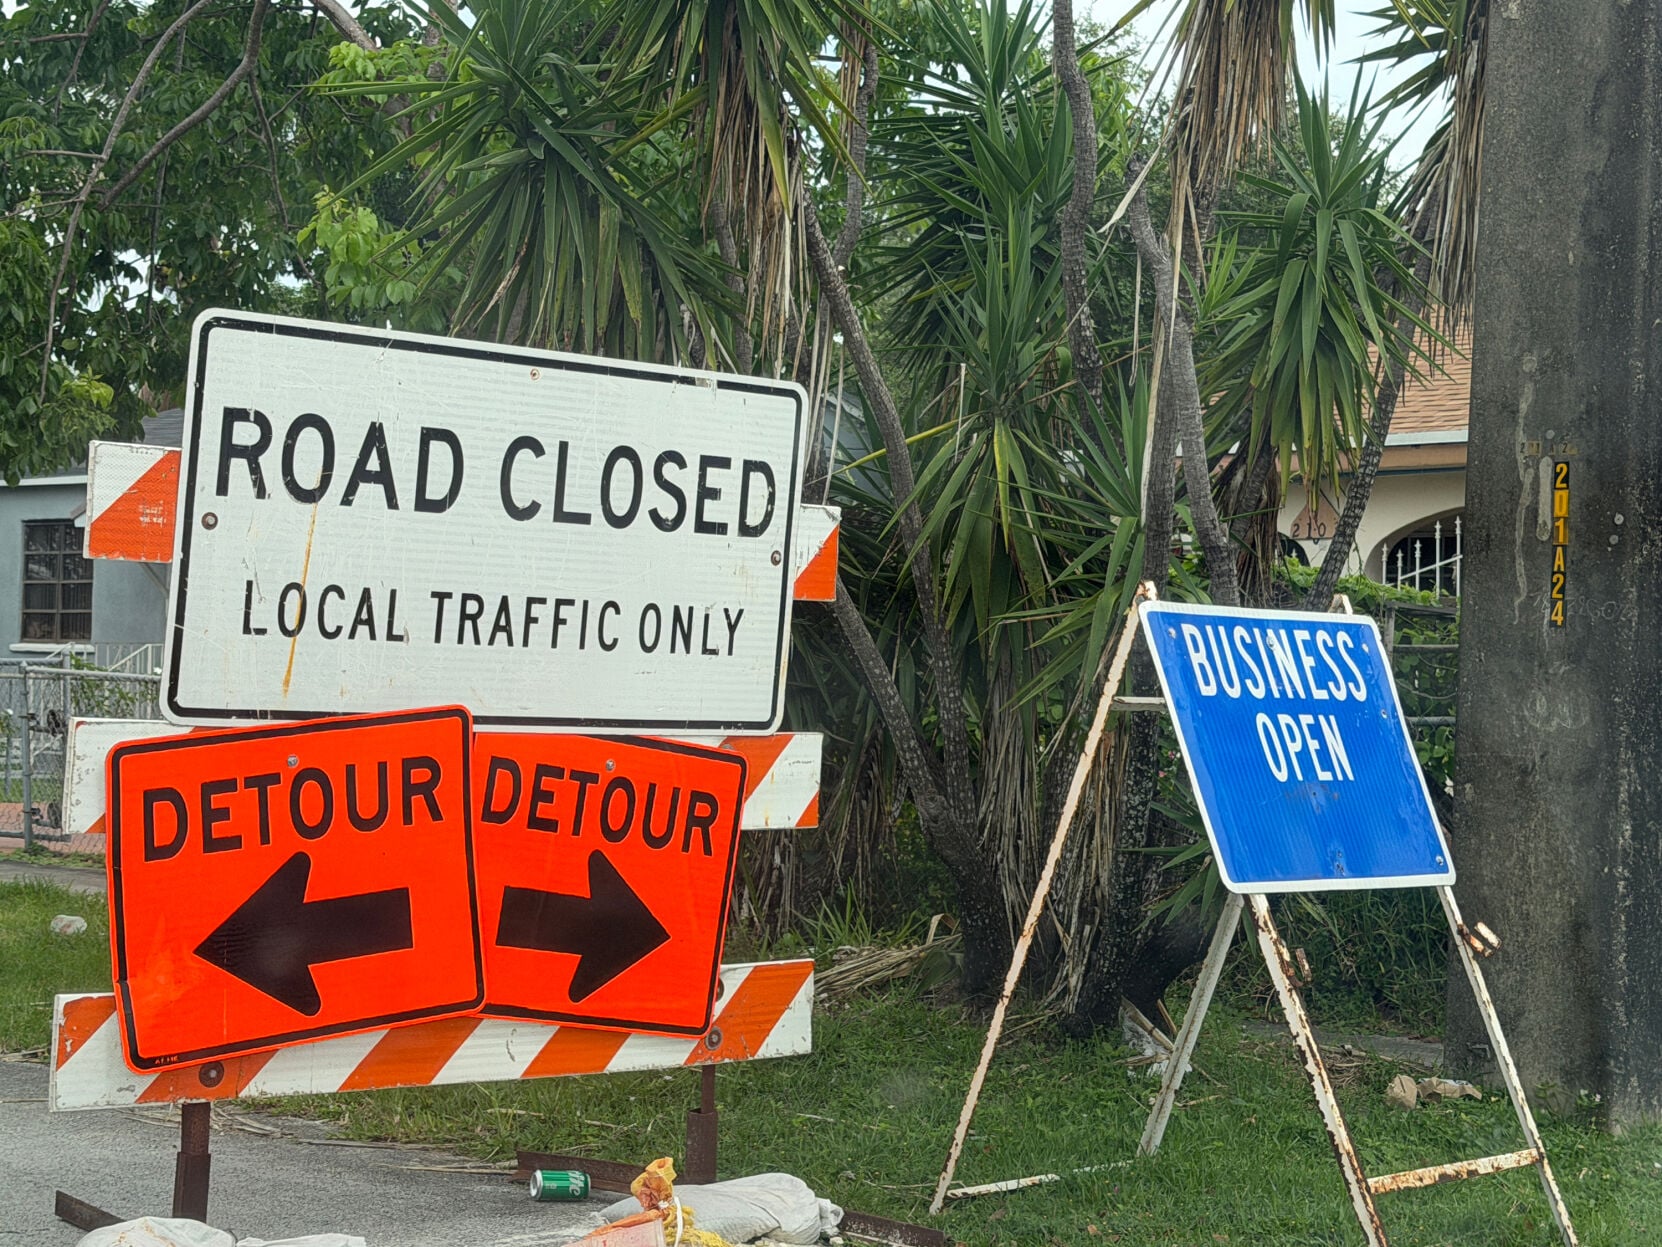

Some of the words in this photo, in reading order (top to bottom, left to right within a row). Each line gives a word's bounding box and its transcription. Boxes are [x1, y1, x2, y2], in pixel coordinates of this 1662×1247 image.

[216, 407, 464, 513] ROAD
[501, 436, 775, 538] CLOSED
[1551, 463, 1569, 627] 201A24
[243, 581, 407, 642] LOCAL
[431, 592, 621, 651] TRAFFIC
[639, 603, 745, 657] ONLY
[1181, 623, 1367, 702] BUSINESS
[1256, 712, 1355, 783] OPEN
[144, 757, 444, 863] DETOUR
[482, 757, 719, 856] DETOUR
